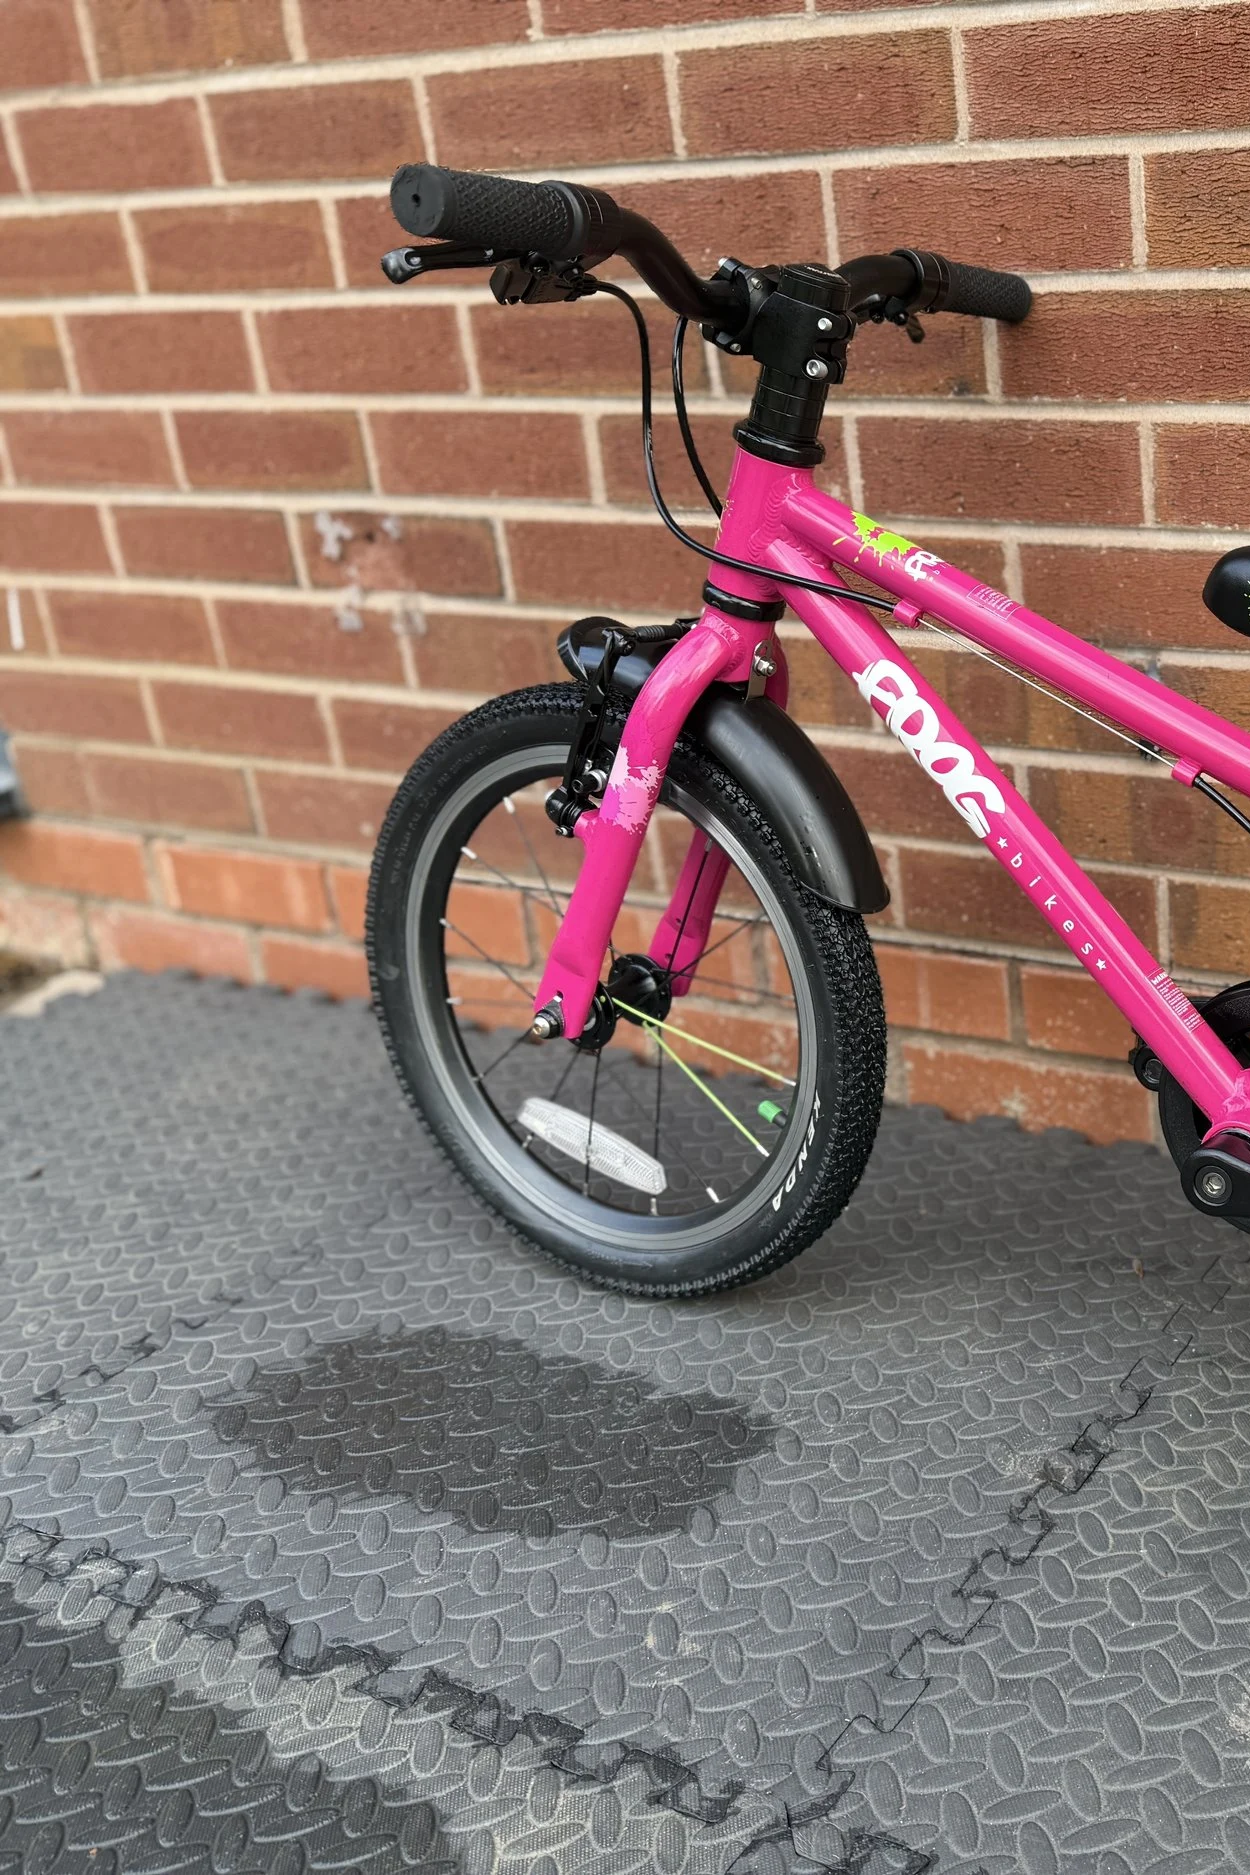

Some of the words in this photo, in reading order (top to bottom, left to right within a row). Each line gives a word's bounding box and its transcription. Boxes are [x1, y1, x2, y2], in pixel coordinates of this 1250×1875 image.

[852, 659, 1005, 839] FROG
[1010, 852, 1093, 956] bikes
[772, 1089, 821, 1212] KENDA
